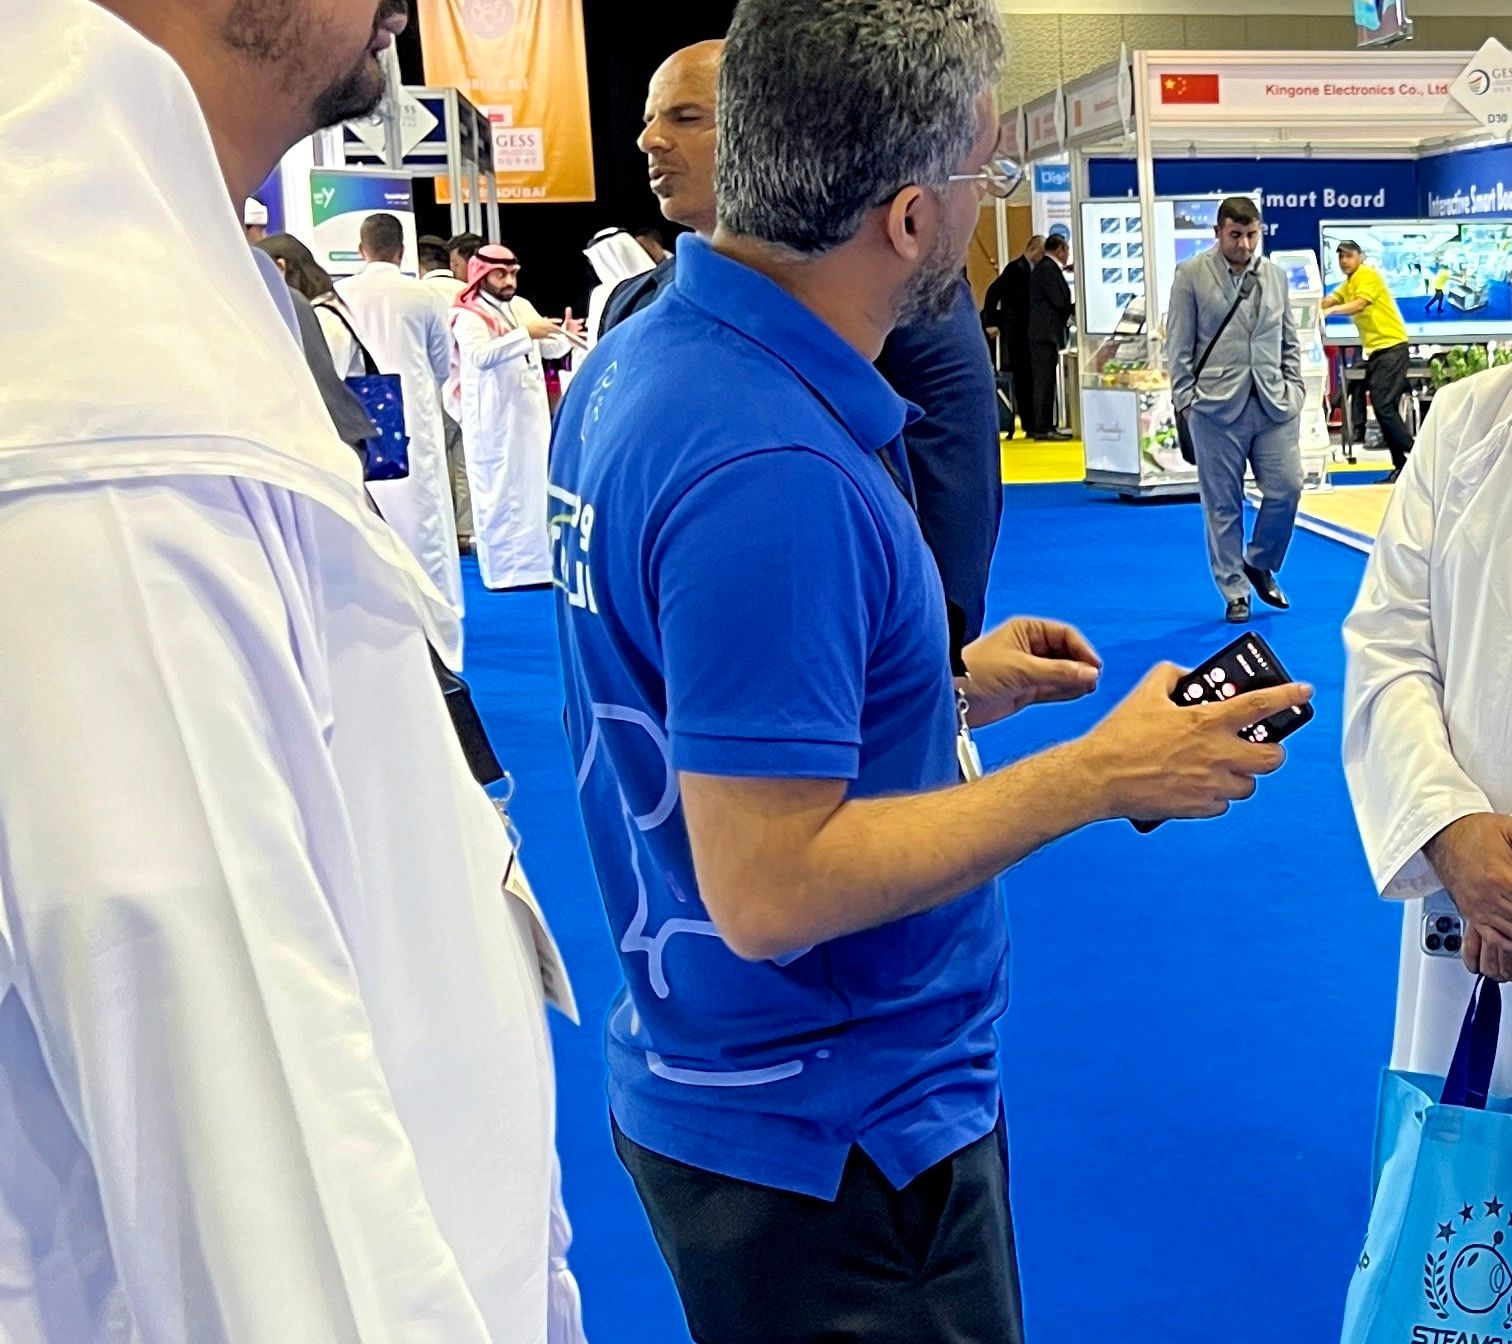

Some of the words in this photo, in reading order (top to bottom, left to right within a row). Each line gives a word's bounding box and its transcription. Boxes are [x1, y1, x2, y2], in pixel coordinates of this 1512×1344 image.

[1265, 84, 1320, 98] Kingone
[1323, 84, 1396, 96] Electronics
[1398, 83, 1425, 97] Co.,
[495, 134, 535, 148] GESS
[1322, 188, 1386, 208] Board
[1428, 189, 1470, 217] Interactive
[1470, 184, 1496, 214] Smart
